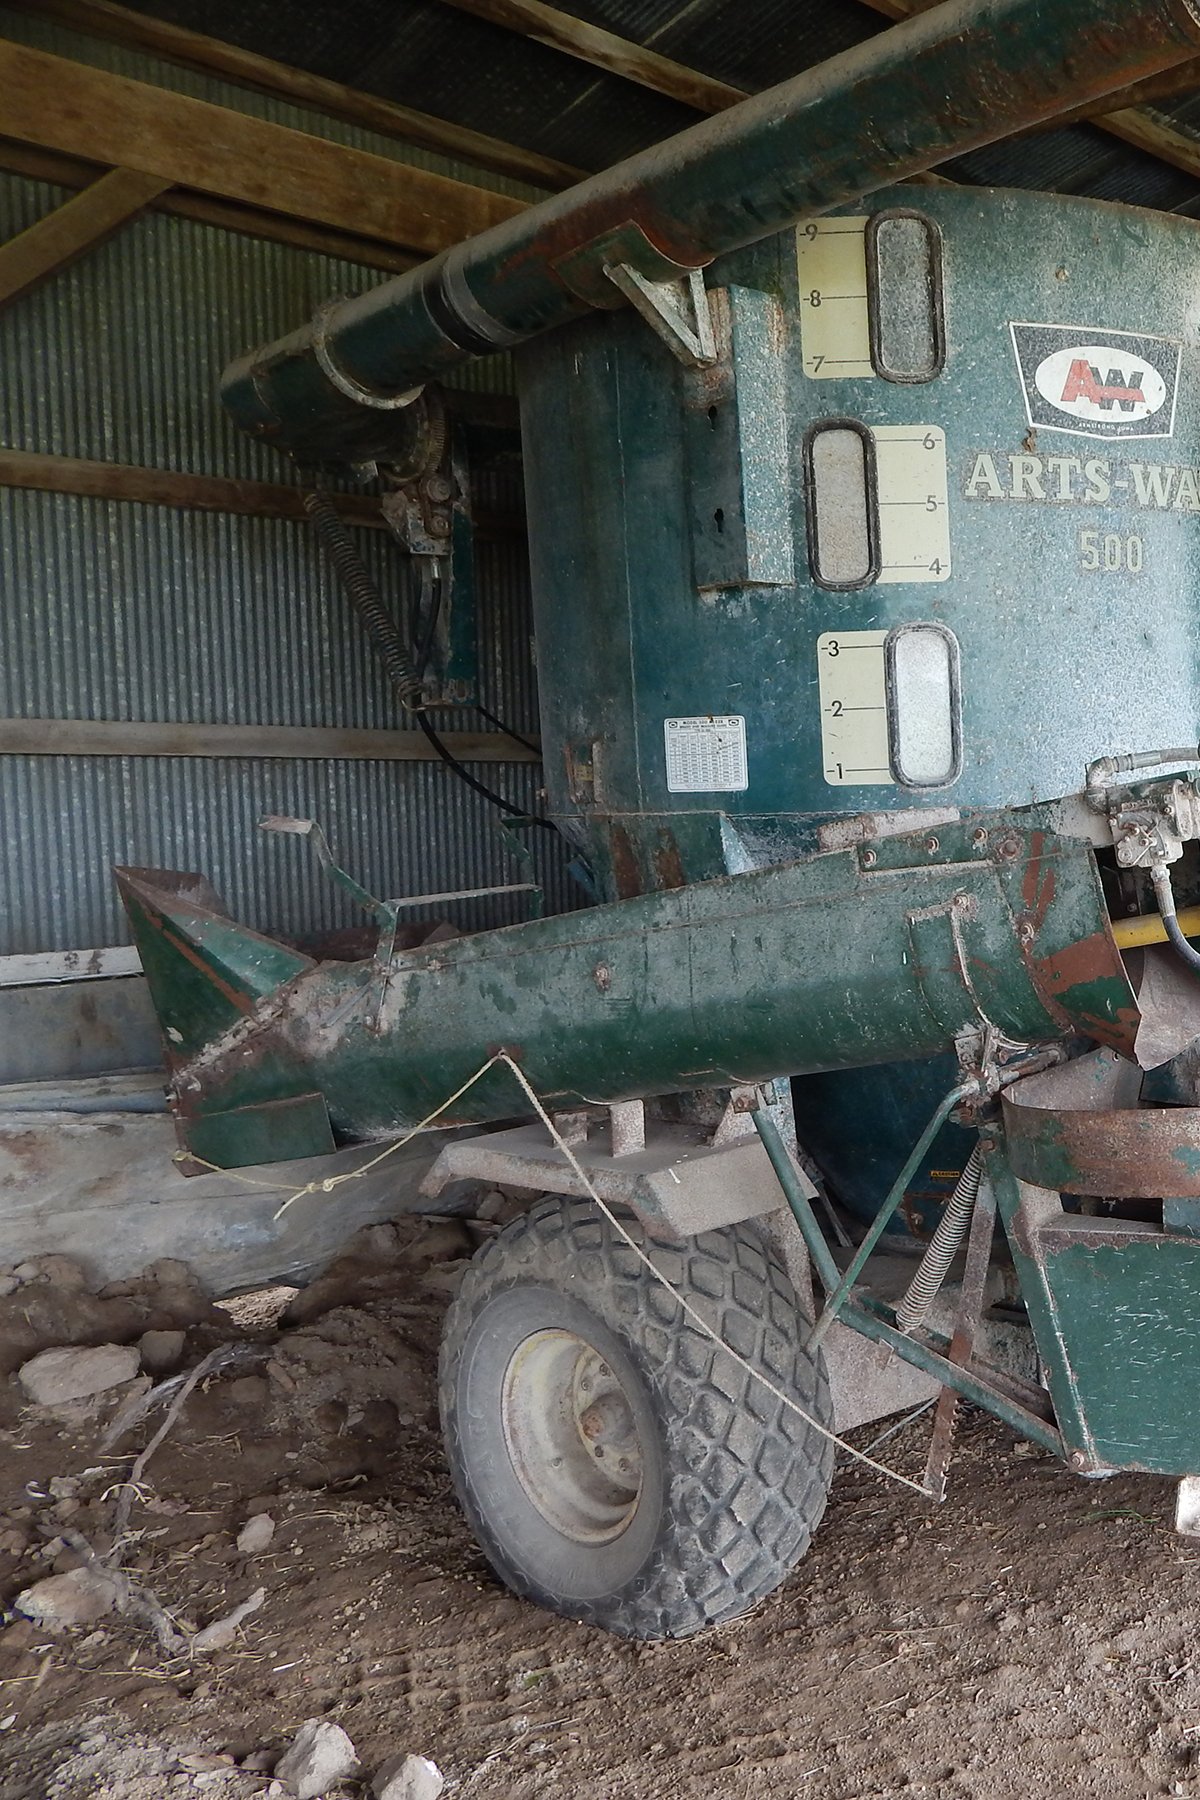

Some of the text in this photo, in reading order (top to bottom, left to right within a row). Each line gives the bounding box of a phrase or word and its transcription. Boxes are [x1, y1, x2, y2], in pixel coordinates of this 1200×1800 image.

[805, 224, 818, 241] 9
[809, 290, 822, 307] 8
[812, 356, 825, 373] 7
[922, 432, 936, 450] 6
[925, 495, 938, 512] 5
[1080, 530, 1144, 573] 500
[928, 558, 942, 575] 4
[828, 640, 840, 657] 3
[831, 700, 844, 717] 2
[836, 763, 844, 779] 1
